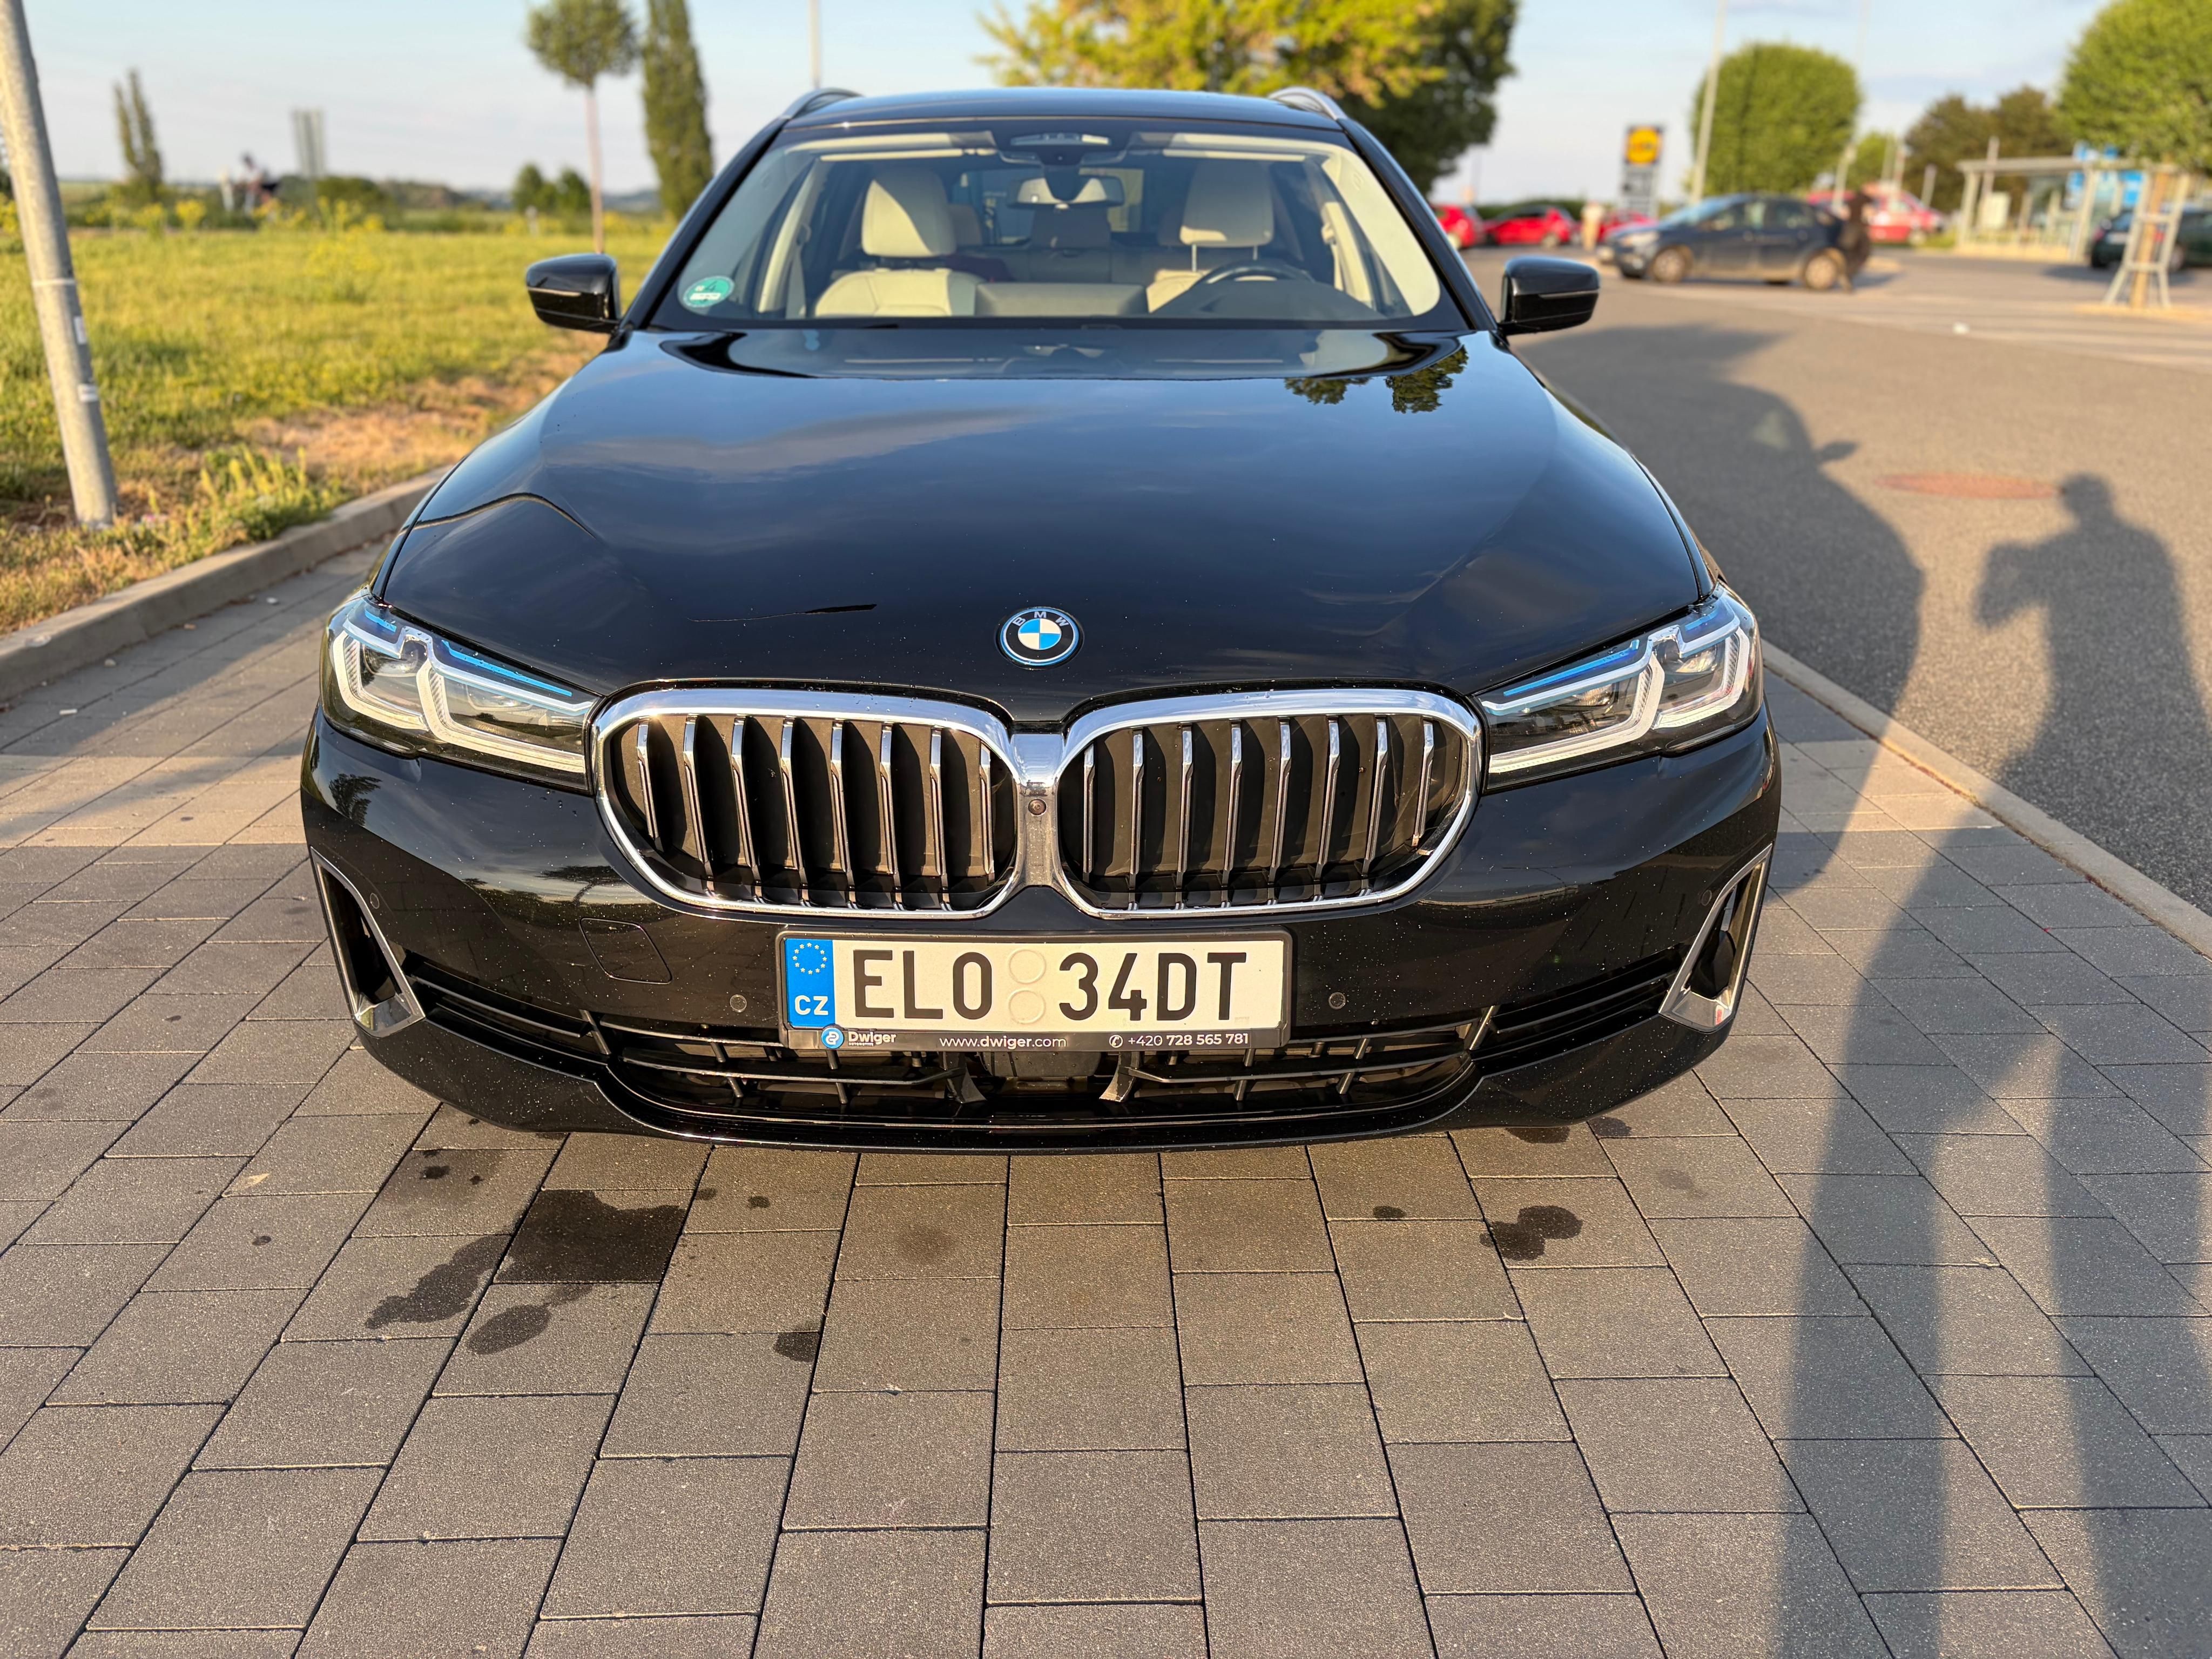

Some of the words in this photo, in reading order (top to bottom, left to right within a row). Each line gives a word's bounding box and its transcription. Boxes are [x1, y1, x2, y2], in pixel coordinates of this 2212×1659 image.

[1012, 611, 1069, 627] BMW
[1058, 952, 1246, 1021] 34DT
[794, 995, 829, 1016] CZ
[848, 1031, 896, 1045] Dwiger
[939, 1035, 1067, 1050] www.dwiger.com
[1128, 1035, 1163, 1046] +420
[1166, 1034, 1192, 1046] 728
[1196, 1034, 1222, 1045] 565
[1225, 1033, 1249, 1044] 781
